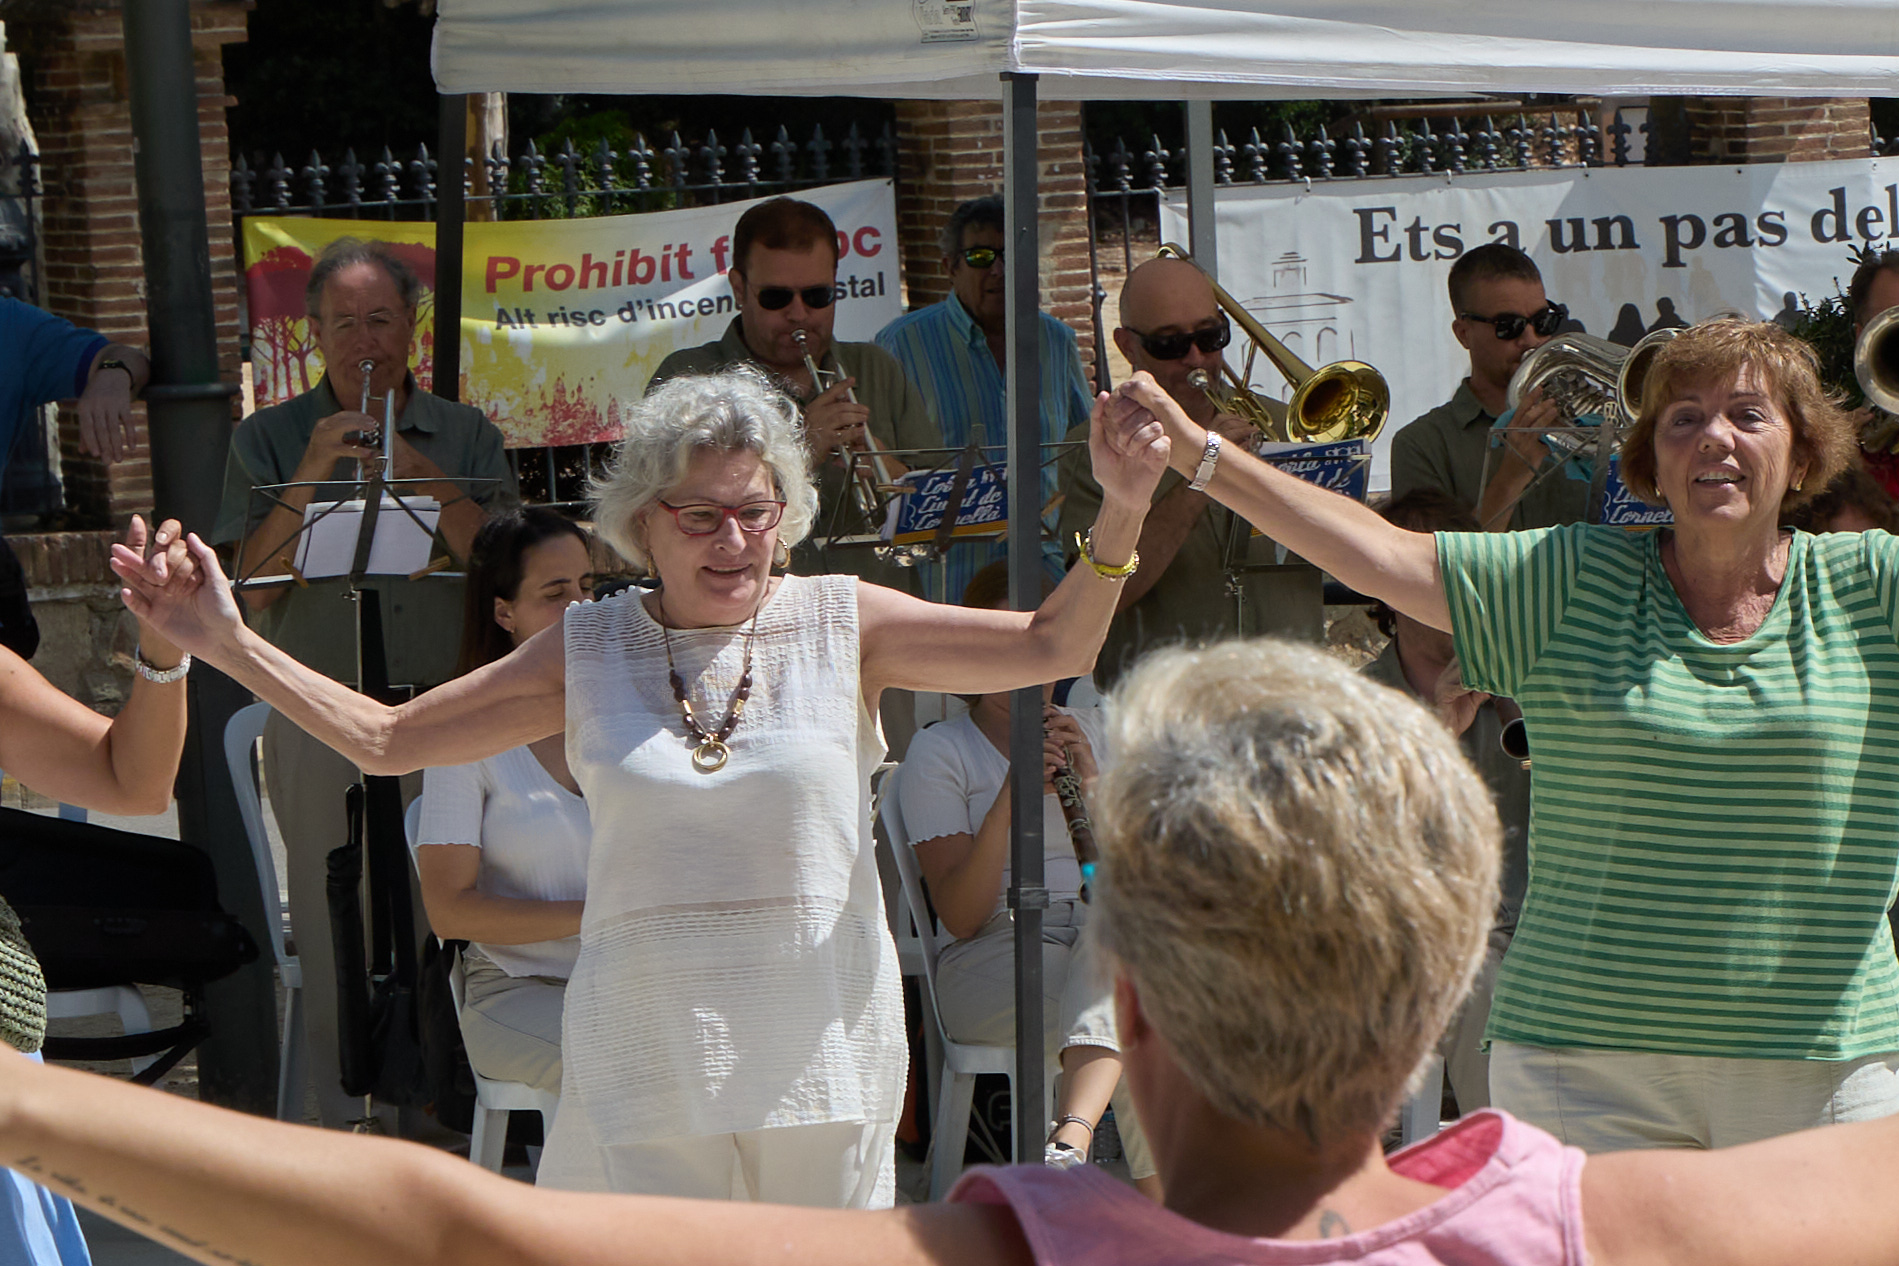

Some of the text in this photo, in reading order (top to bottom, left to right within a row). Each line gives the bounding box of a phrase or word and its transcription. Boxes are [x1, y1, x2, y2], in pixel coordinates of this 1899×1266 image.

[1353, 206, 1464, 262] Ets
[1545, 215, 1641, 253] un
[1659, 211, 1788, 268] pas
[486, 243, 695, 293] Prohibit
[496, 307, 536, 330] Alt
[547, 307, 606, 327] risc
